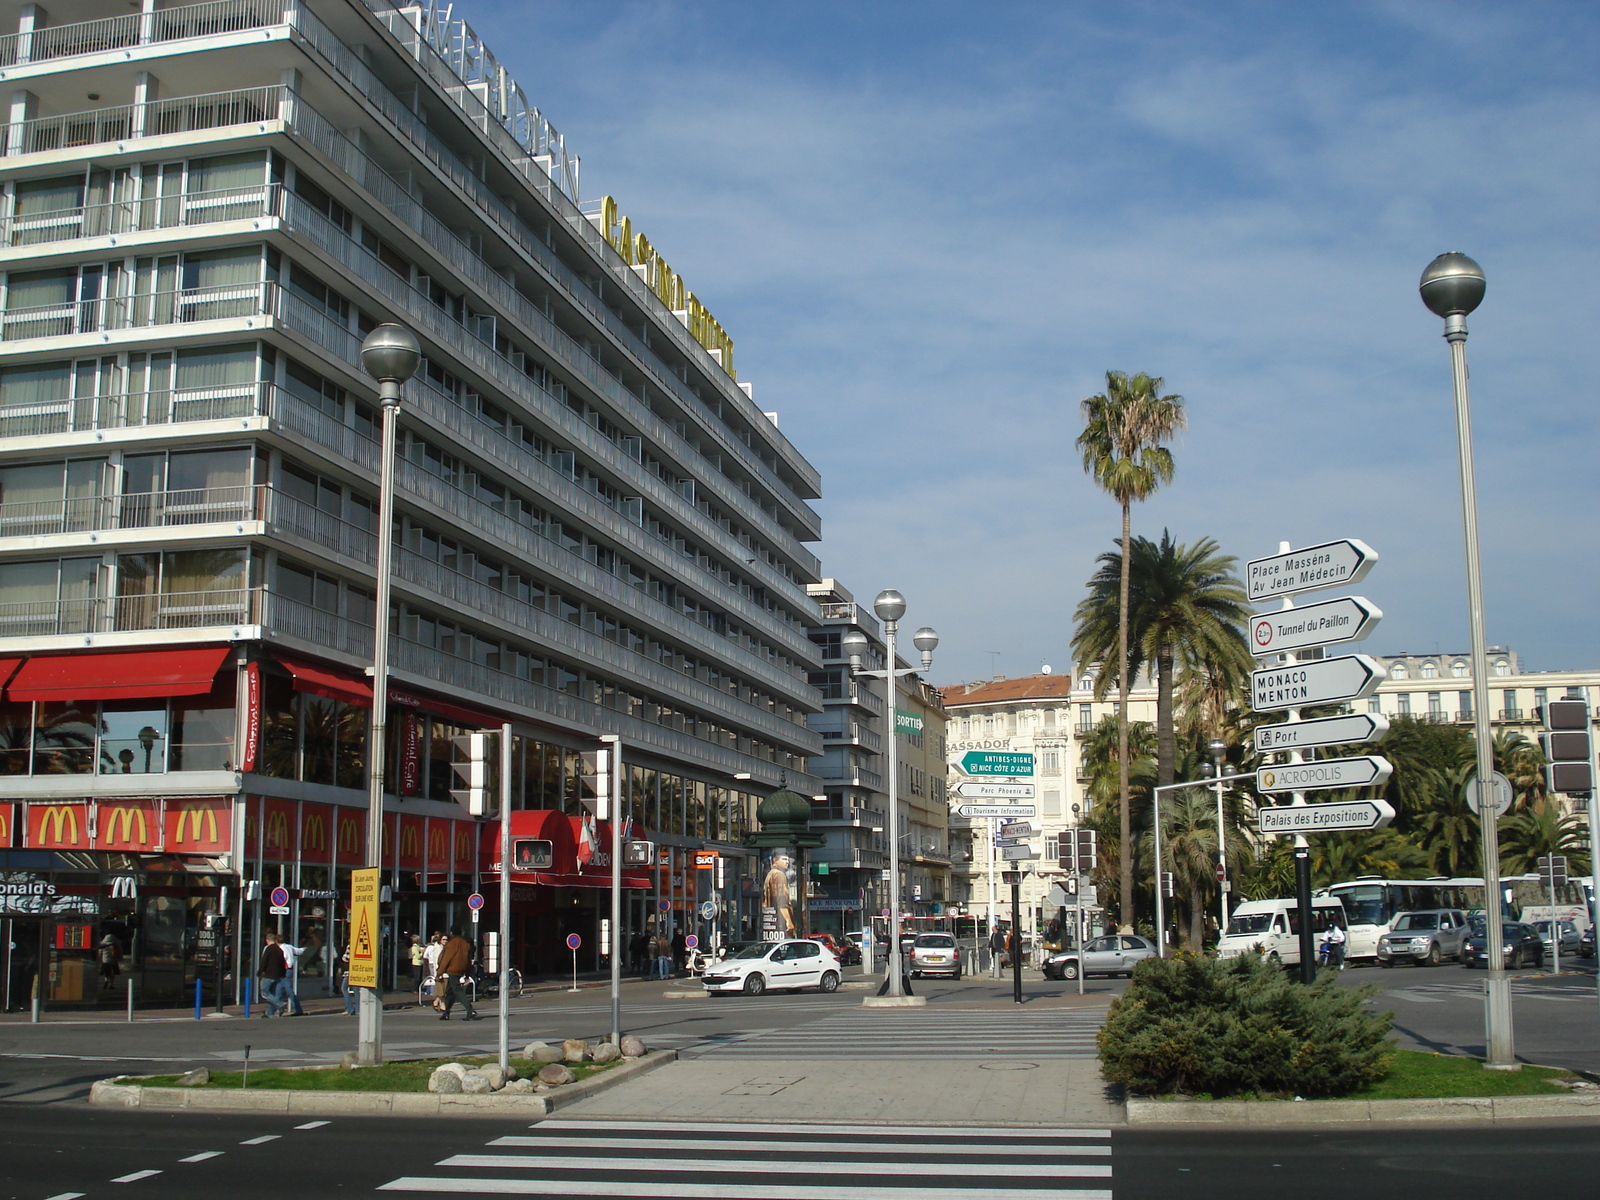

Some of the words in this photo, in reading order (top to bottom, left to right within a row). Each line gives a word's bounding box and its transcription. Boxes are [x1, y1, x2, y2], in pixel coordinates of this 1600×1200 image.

[602, 195, 686, 312] CASINO
[1252, 566, 1280, 578] Place
[1285, 553, 1331, 571] Masséna
[1253, 582, 1265, 593] Av
[1270, 576, 1295, 590] Jean
[1300, 565, 1346, 583] Médecin
[1277, 621, 1305, 637] Tunnel
[1307, 619, 1318, 632] du
[1320, 615, 1349, 630] Paillon
[1258, 671, 1307, 689] MONACO
[1258, 686, 1307, 704] MENTON
[897, 716, 920, 731] SORTIE
[1275, 730, 1298, 743] Port
[405, 762, 416, 788] Café
[978, 764, 992, 772] NICE
[994, 763, 1009, 773] CÔTE
[1010, 765, 1032, 773] D'AZUR
[1279, 767, 1342, 785] ACROPOLIS
[973, 807, 999, 815] Tourisme
[1000, 807, 1034, 816] Information
[1265, 813, 1292, 826] Palais
[1294, 812, 1310, 825] des
[1313, 810, 1369, 827] Expositions
[763, 931, 785, 940] BLOOD
